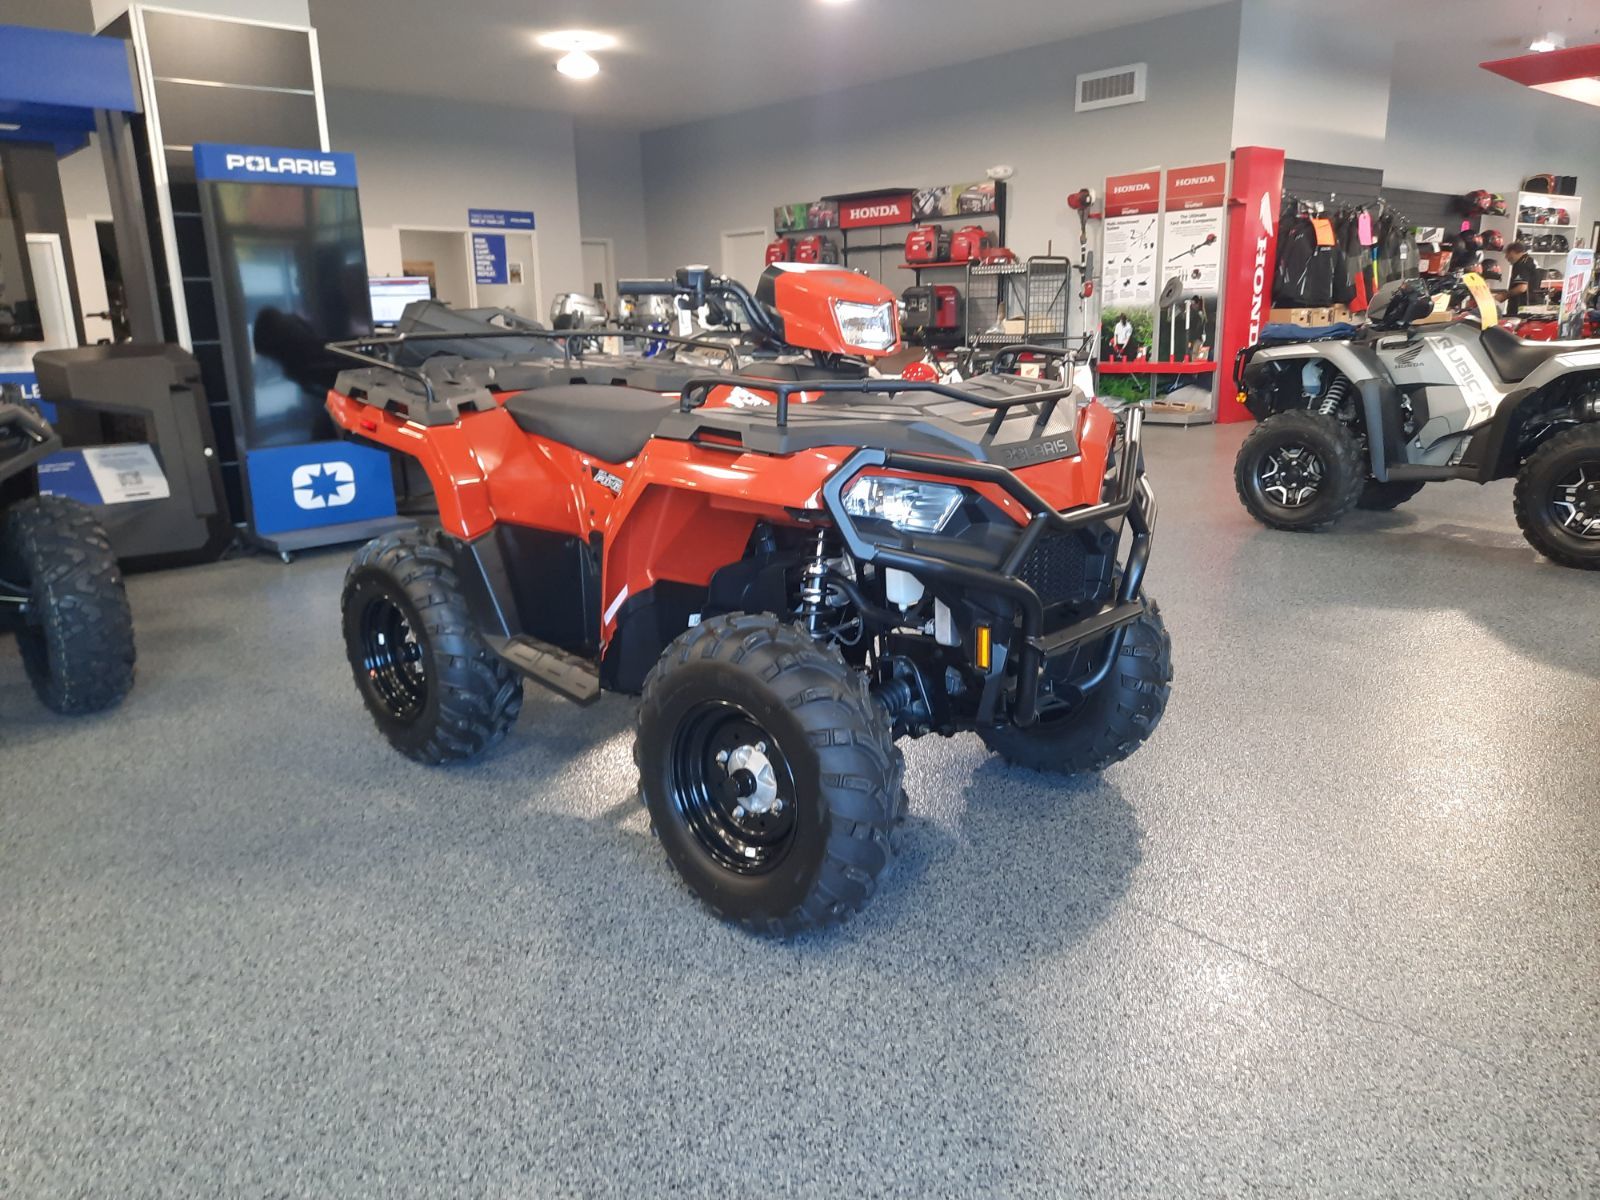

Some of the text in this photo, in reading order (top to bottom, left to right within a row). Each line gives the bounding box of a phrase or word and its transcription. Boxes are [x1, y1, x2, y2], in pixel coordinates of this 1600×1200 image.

[226, 154, 336, 176] POLARIS
[1113, 183, 1151, 194] HONDA
[1175, 175, 1215, 187] HONDA
[850, 204, 900, 220] HONDA
[1249, 236, 1267, 347] HOND
[1437, 336, 1492, 418] RUBICON
[1005, 439, 1068, 460] POLARIS
